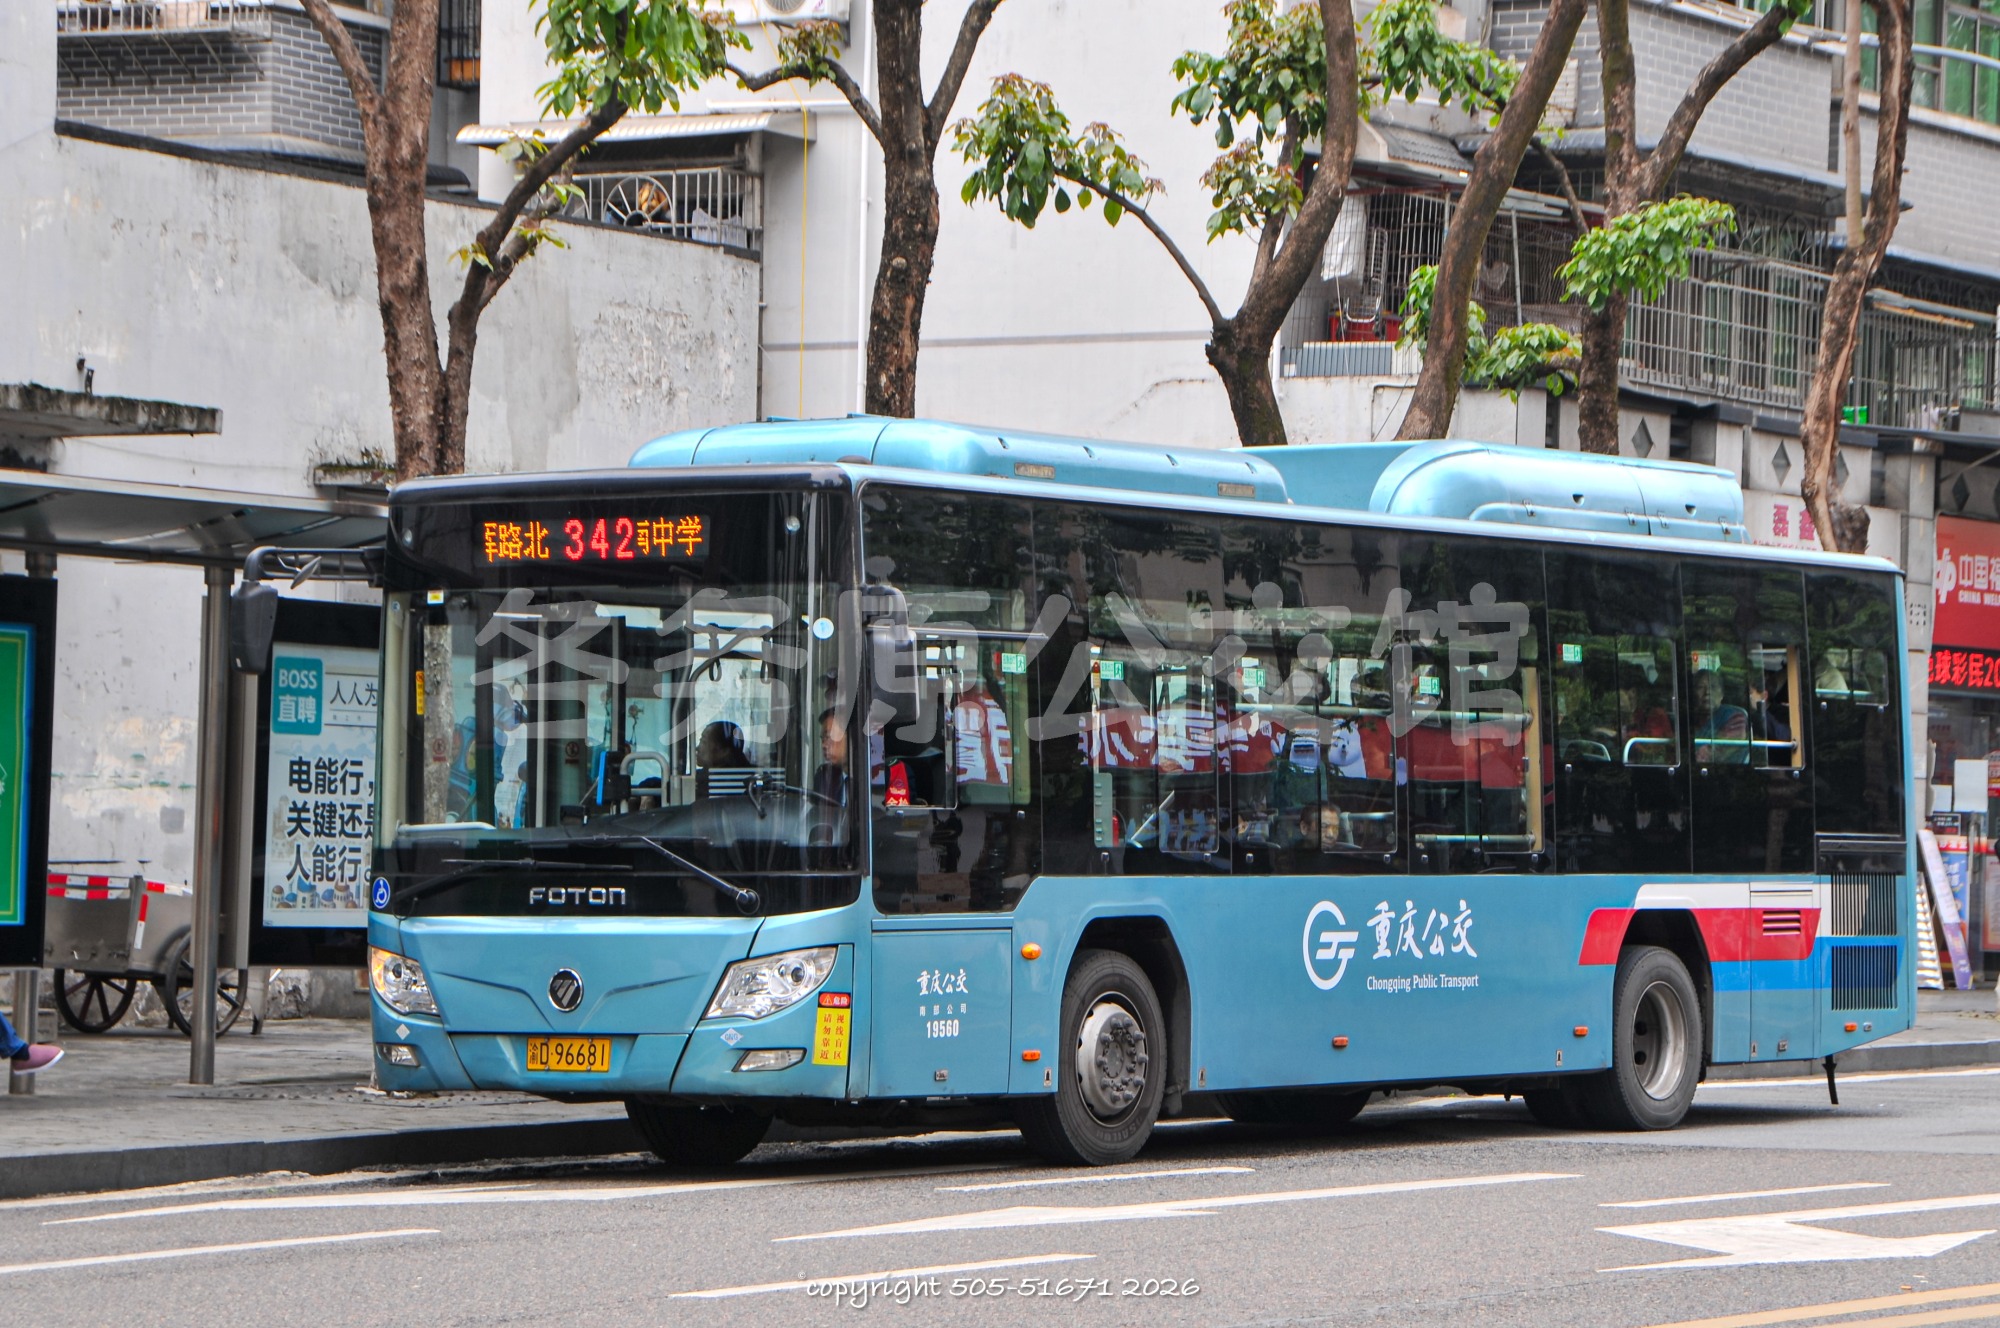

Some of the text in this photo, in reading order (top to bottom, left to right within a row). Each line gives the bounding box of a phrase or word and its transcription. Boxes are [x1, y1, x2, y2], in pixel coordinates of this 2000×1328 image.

[564, 517, 635, 561] 342
[278, 668, 318, 689] BOSS
[277, 694, 317, 724] 直聘
[529, 887, 626, 905] FOTON
[1366, 899, 1478, 960] 重庆公交
[916, 968, 969, 996] 重庆公交
[1366, 973, 1479, 993] Chongqing Public Transport
[833, 996, 848, 1005] 危险
[926, 1018, 959, 1039] 19560
